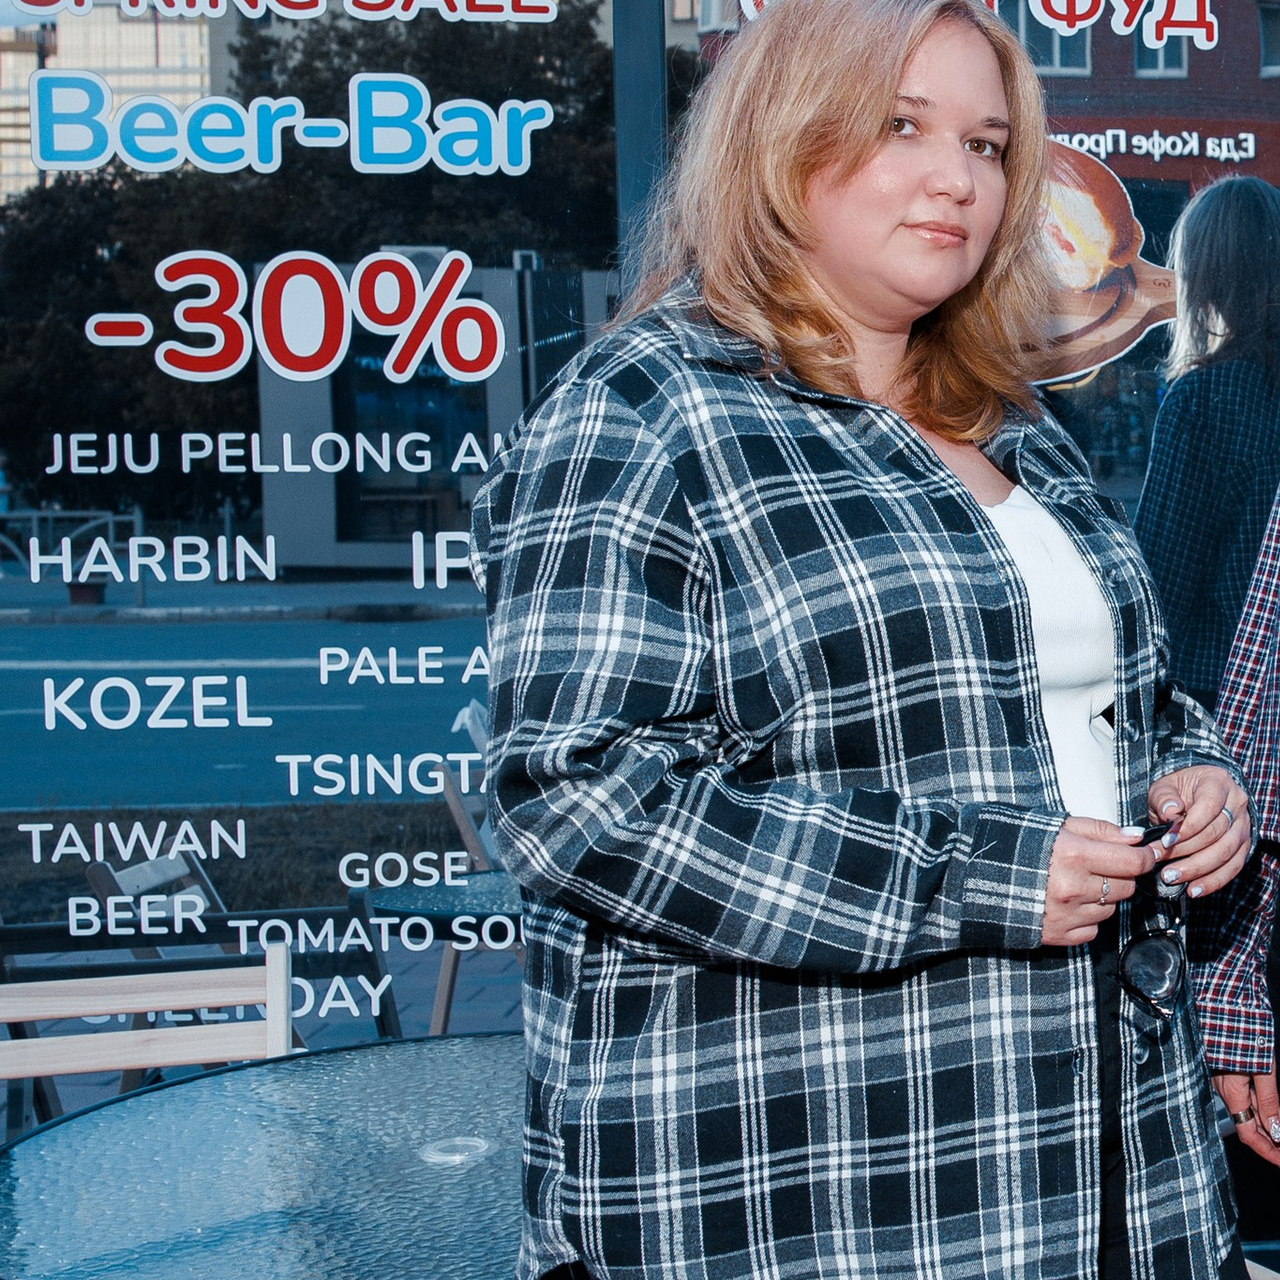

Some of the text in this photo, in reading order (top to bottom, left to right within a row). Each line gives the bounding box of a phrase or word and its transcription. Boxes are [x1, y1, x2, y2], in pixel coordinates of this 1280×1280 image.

[33, 73, 550, 171] Beer-Bar
[90, 254, 501, 378] -30%
[45, 432, 160, 474] JEJU
[181, 431, 432, 473] PELLONG
[29, 535, 276, 583] HARBIN
[412, 530, 471, 590] IP
[319, 646, 444, 685] PALE
[43, 675, 273, 730] KOZEL
[275, 753, 488, 796] TSINGT
[18, 819, 246, 863] TAIWAN
[338, 851, 469, 888] GOSE
[68, 894, 207, 936] BEER
[228, 915, 527, 955] TOMATO SO
